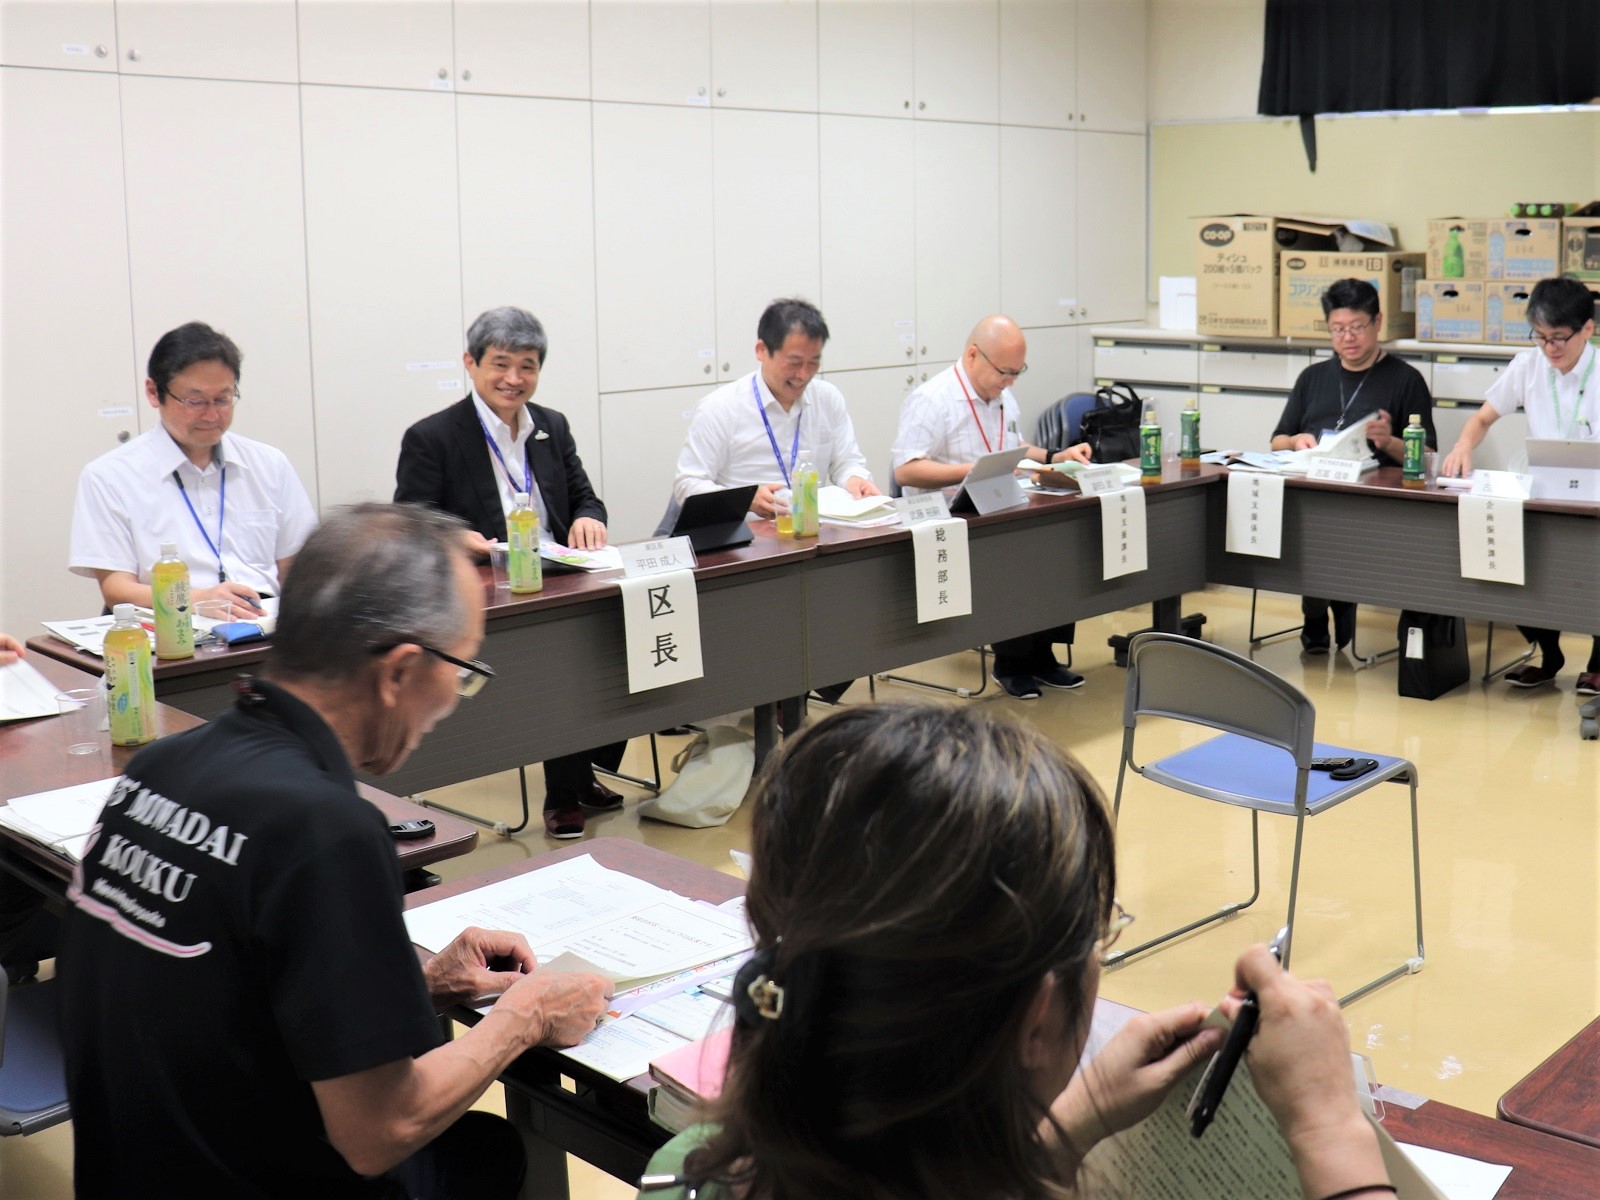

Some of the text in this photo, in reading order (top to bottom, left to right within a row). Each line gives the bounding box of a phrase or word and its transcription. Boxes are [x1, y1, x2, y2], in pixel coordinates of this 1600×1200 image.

[636, 554, 681, 571] 平田 成人
[935, 527, 948, 605] 総務部長
[647, 584, 678, 667] 区長
[99, 833, 198, 902] KOUKU
